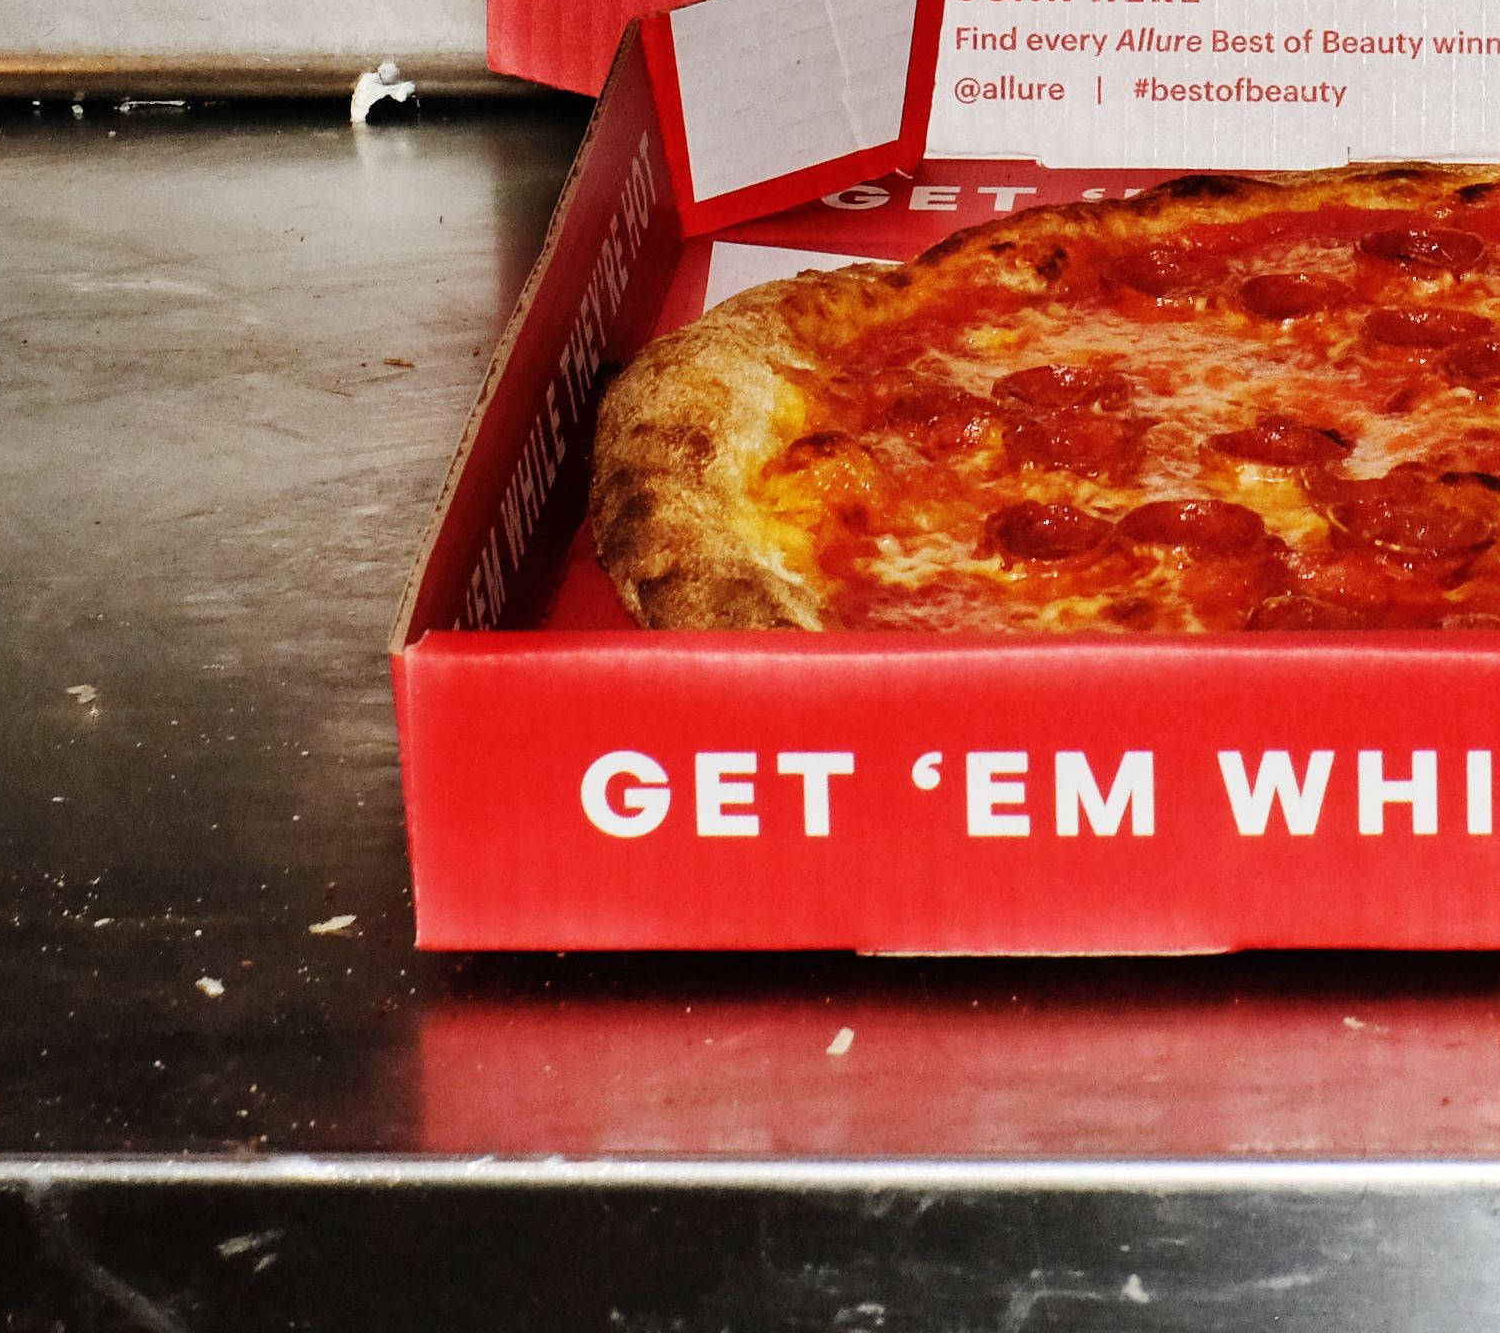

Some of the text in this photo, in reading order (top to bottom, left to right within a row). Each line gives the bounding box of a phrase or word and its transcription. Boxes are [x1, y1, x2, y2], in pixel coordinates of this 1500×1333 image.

[955, 27, 1018, 51] Find
[1026, 33, 1108, 56] every
[1115, 27, 1203, 53] Allure
[1211, 30, 1275, 53] Best
[1283, 29, 1313, 53] of
[1322, 30, 1424, 59] Beauty
[954, 76, 1347, 107] @allure #bestofbeauty
[821, 185, 1038, 213] GET
[501, 380, 567, 573] WHILE
[621, 129, 657, 261] HOT
[580, 750, 855, 838] GET
[911, 751, 1155, 837] ‘EM
